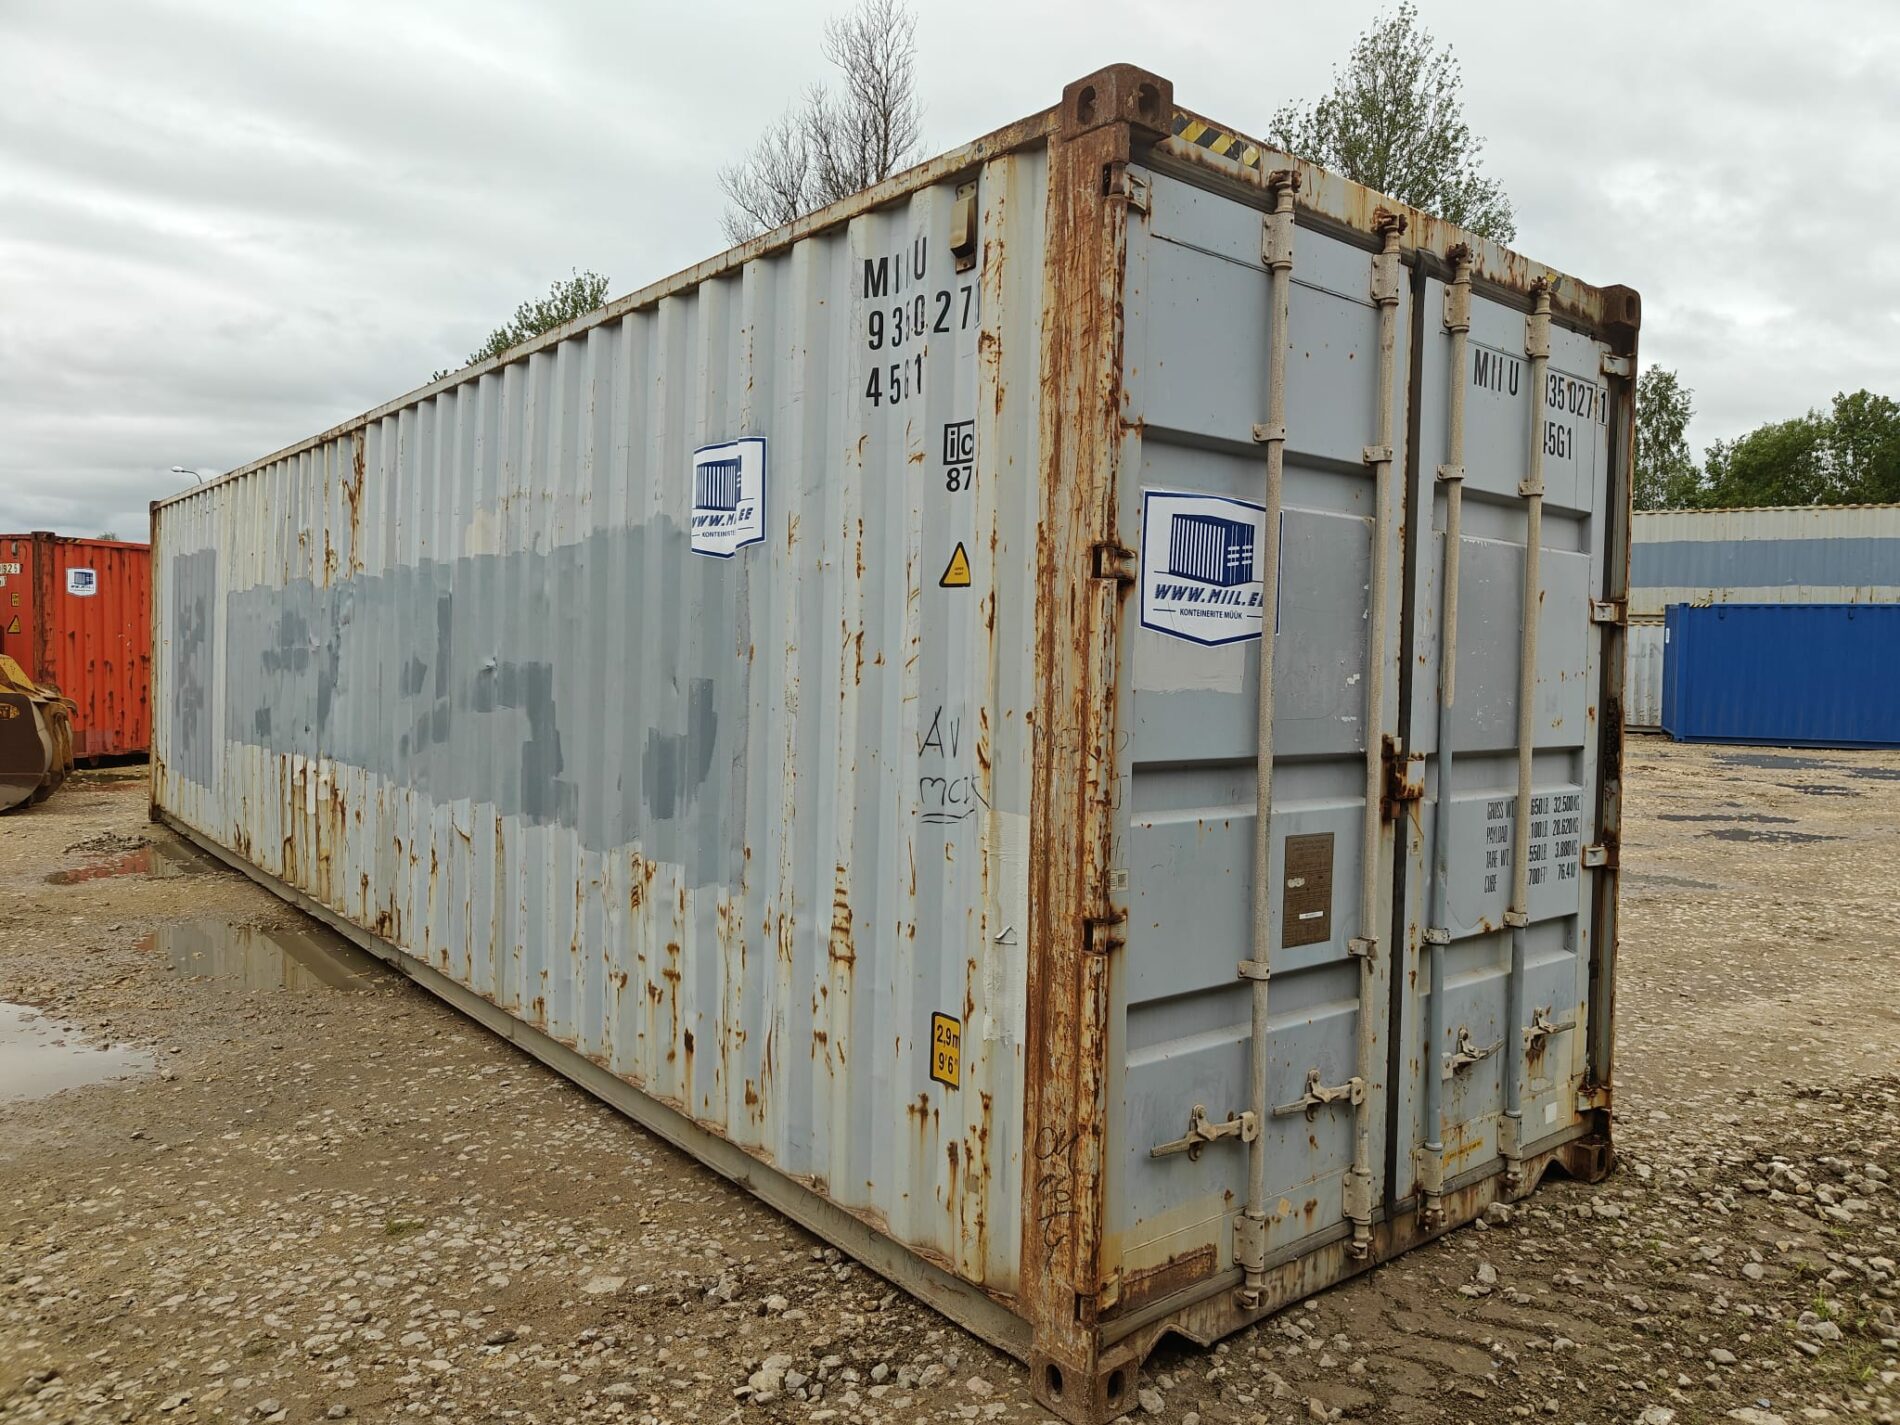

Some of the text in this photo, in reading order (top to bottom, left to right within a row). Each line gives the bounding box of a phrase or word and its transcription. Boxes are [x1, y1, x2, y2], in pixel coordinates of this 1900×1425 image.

[863, 236, 927, 299] MIIU
[1473, 349, 1520, 396] MIIU
[946, 466, 973, 492] 87
[1179, 608, 1223, 619] KONTEINERITE
[1486, 801, 1504, 820] GROSS
[1486, 825, 1508, 844] PAYLOAD
[1486, 849, 1498, 869] TARE
[1500, 848, 1510, 867] WT
[1484, 874, 1497, 893] CUBE
